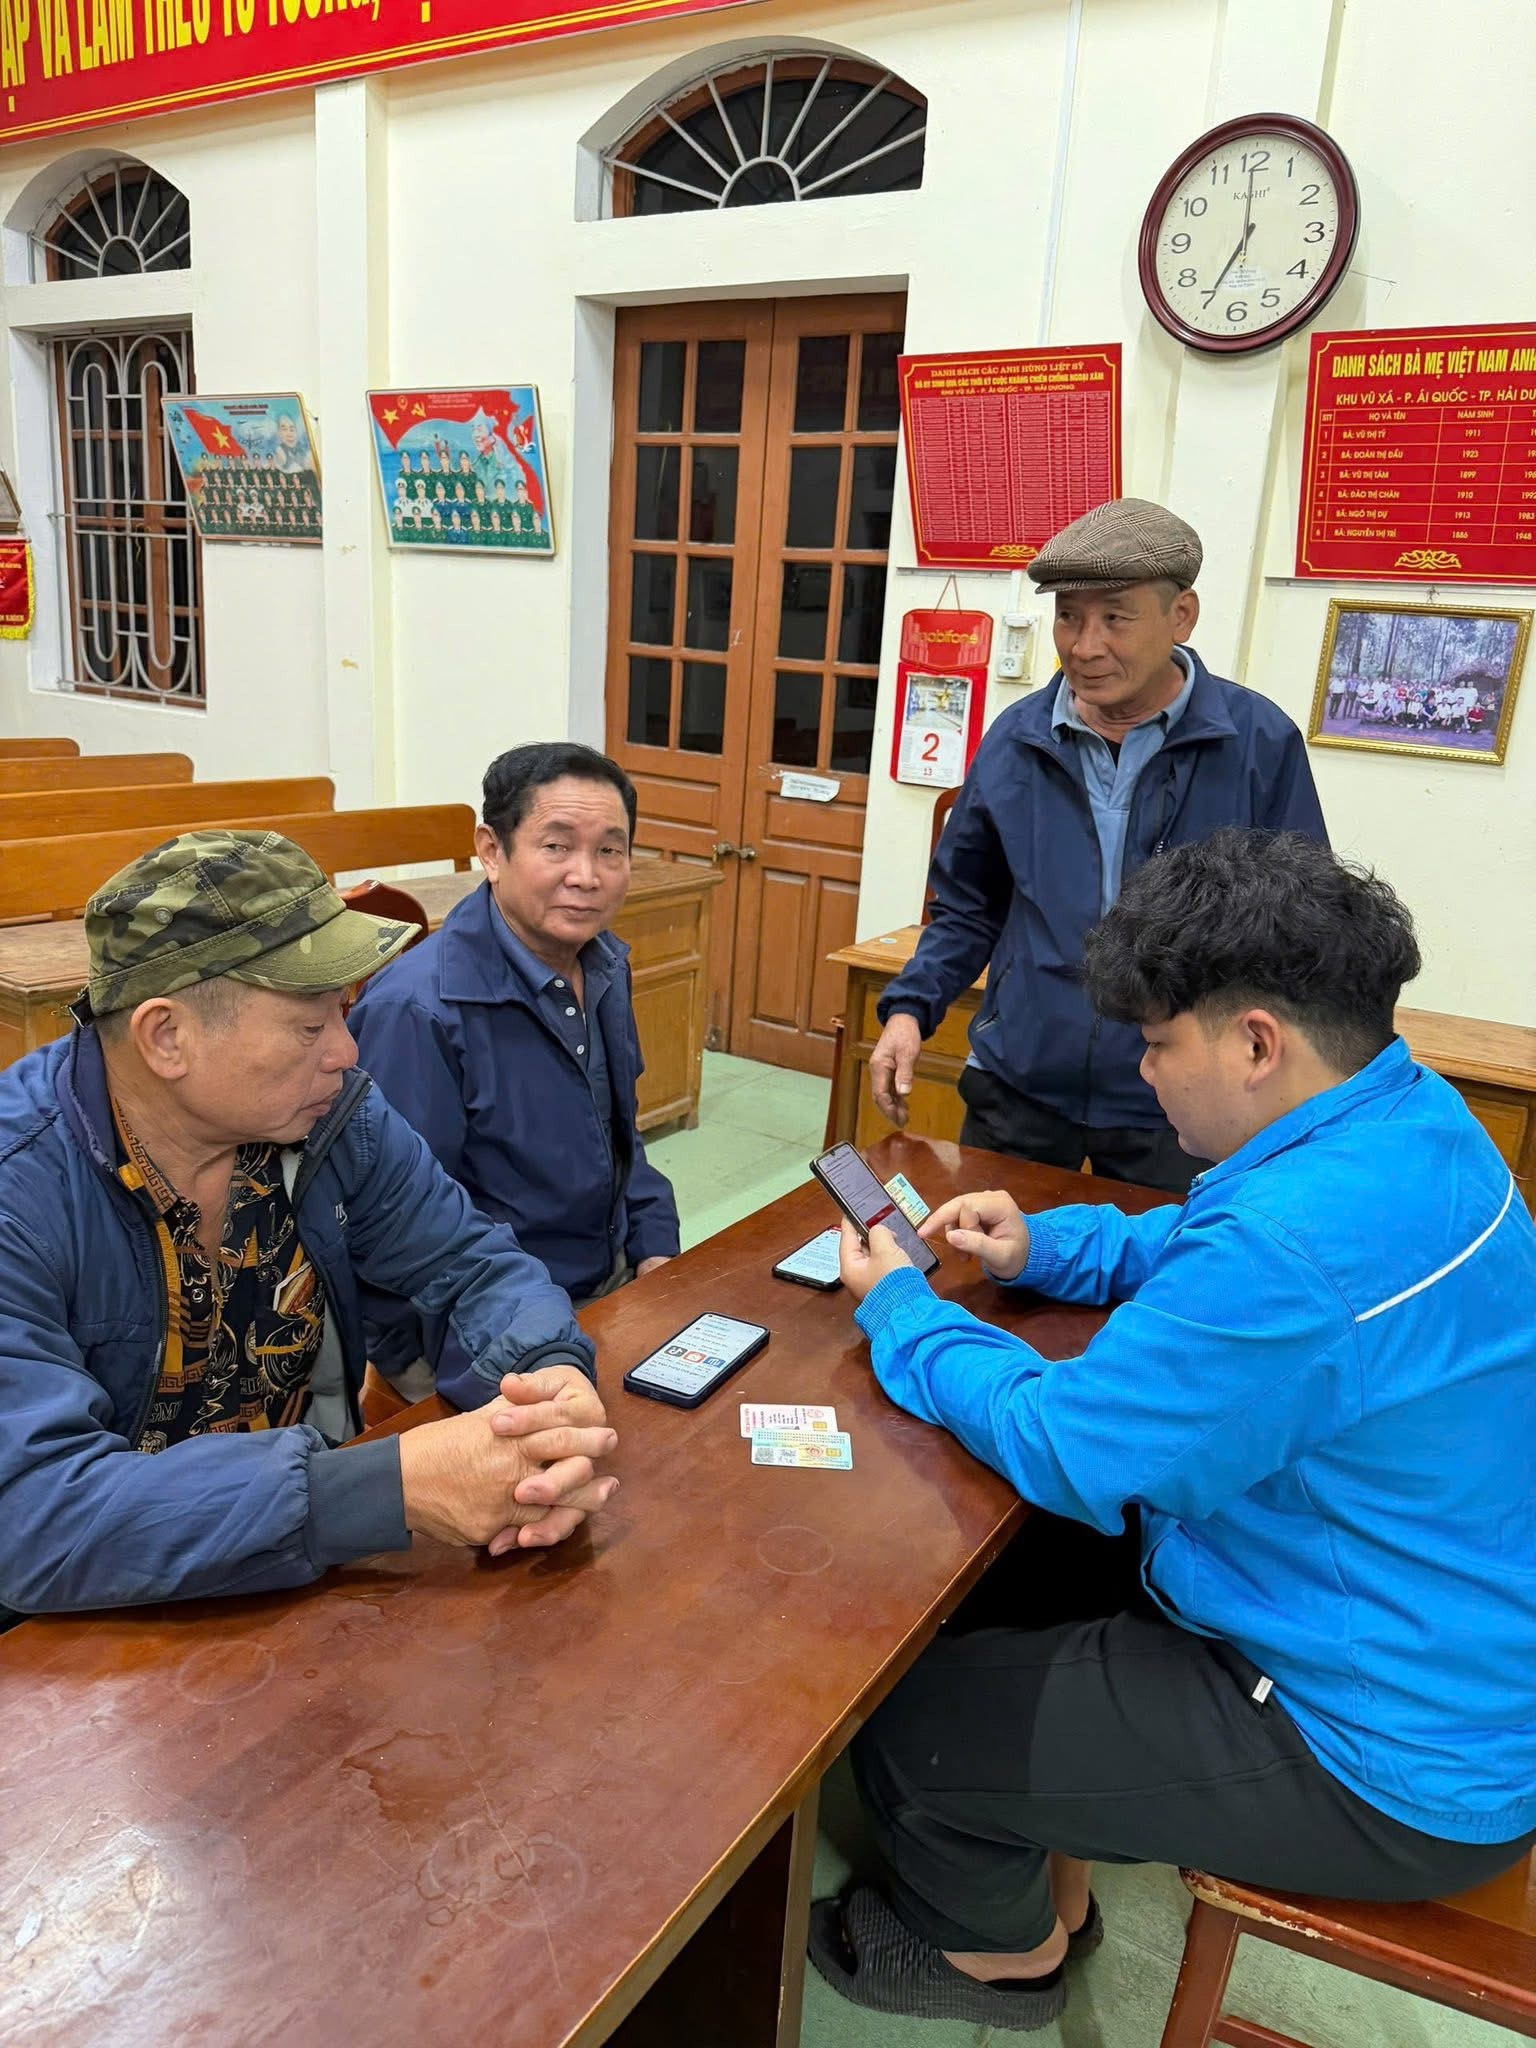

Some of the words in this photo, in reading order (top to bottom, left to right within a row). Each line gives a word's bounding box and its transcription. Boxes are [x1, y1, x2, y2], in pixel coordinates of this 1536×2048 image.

[1240, 151, 1270, 173] 12
[1287, 156, 1294, 178] 1
[1211, 163, 1229, 185] 11
[1298, 184, 1321, 206] 2
[1183, 197, 1208, 218] 10
[1303, 221, 1325, 243] 3
[1171, 233, 1191, 254] 9
[1177, 268, 1197, 288] 8
[1286, 259, 1309, 279] 4
[1200, 290, 1217, 310] 7
[1260, 288, 1281, 308] 5
[1226, 301, 1248, 322] 6
[1000, 366, 1020, 374] ANH
[1022, 364, 1048, 372] HÙNG
[1332, 355, 1366, 378] DANH
[1368, 349, 1402, 377] SÁCH
[1404, 347, 1421, 376] BÀ
[1424, 352, 1445, 380] MẸ
[1448, 346, 1476, 379] VIỆT
[1477, 349, 1509, 373] NAM
[1336, 393, 1358, 406] KHU
[1361, 391, 1376, 405] VŨ
[1378, 389, 1394, 404] XÁ
[1405, 392, 1414, 404] P.
[1417, 388, 1430, 403] ÁI
[1432, 386, 1468, 402] QUỐC
[1480, 390, 1494, 402] TP.
[1497, 385, 1518, 401] HẢI
[1322, 413, 1333, 422] STT
[1369, 412, 1380, 422] HỌ
[1382, 411, 1392, 420] VÀ
[1394, 411, 1406, 420] TÊN
[1458, 409, 1476, 418] NĂM
[1477, 410, 1495, 418] SINH
[1324, 431, 1328, 439] 1
[1465, 429, 1480, 438] 1911
[1463, 450, 1479, 458] 1923
[1460, 471, 1477, 479] 1899
[1519, 512, 1535, 520] 1983
[1452, 531, 1468, 539] 1886
[1516, 532, 1532, 540] 1948
[921, 733, 940, 762] 2
